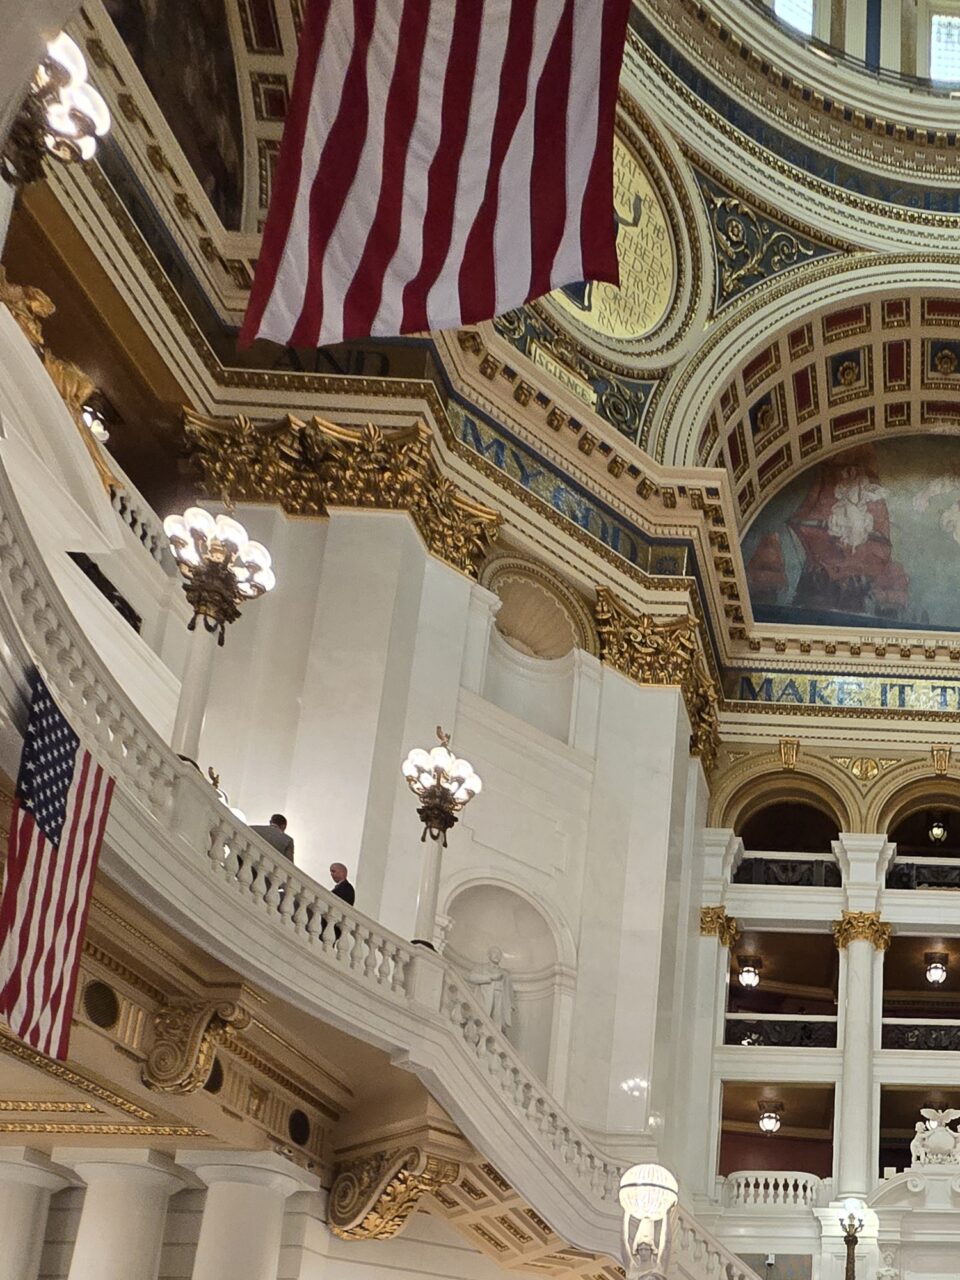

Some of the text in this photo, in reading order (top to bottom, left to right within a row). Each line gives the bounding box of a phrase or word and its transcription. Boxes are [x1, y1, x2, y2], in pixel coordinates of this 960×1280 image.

[614, 146, 637, 178] HAT
[273, 346, 390, 376] AND
[536, 350, 591, 402] SCIENCE
[460, 415, 544, 487] MY
[737, 675, 864, 706] MAKE
[880, 683, 914, 708] IT
